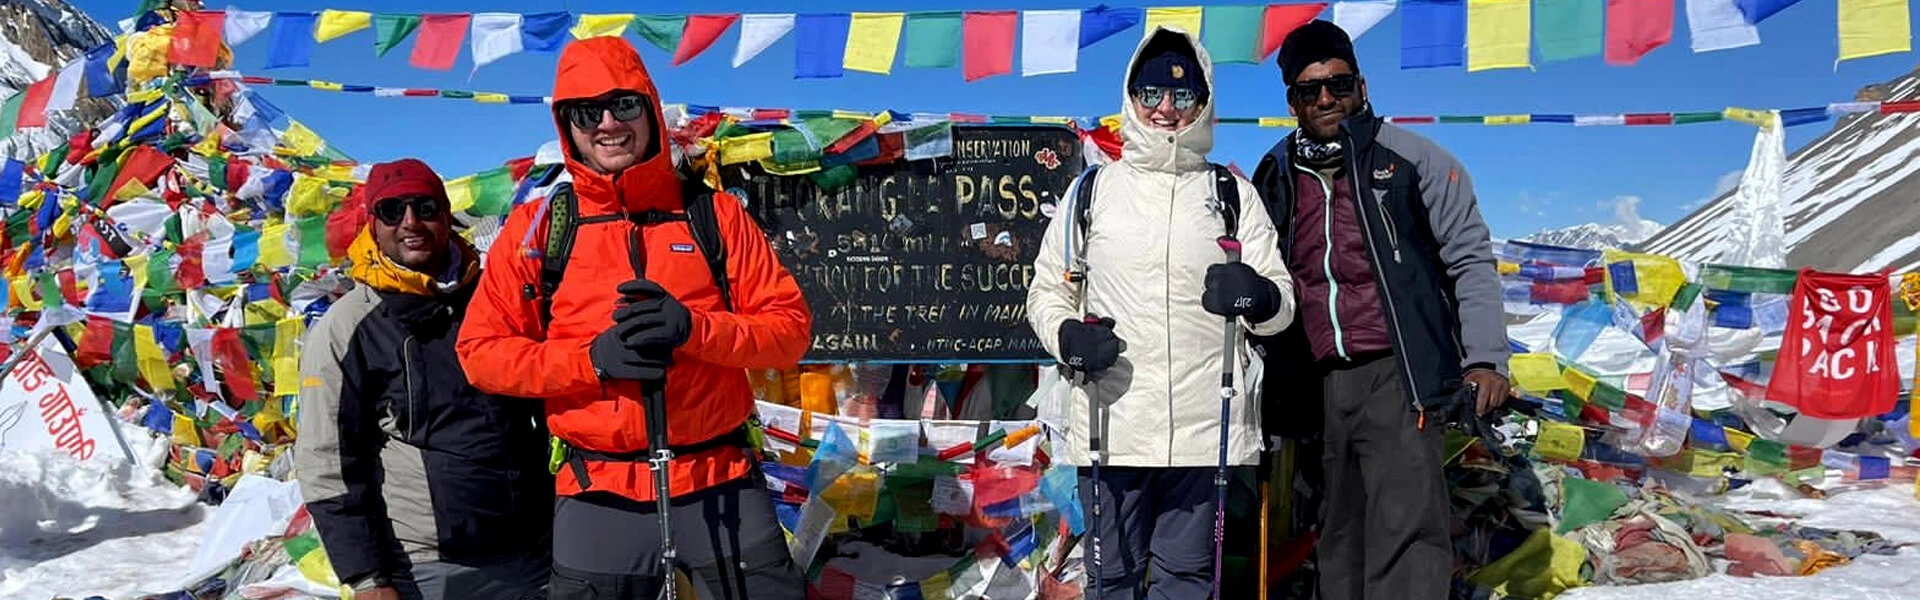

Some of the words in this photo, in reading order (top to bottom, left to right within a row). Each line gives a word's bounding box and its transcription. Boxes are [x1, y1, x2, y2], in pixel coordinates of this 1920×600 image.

[956, 139, 1030, 159] NSERVATION
[955, 174, 1039, 219] PASS
[960, 262, 1034, 292] SUCCE
